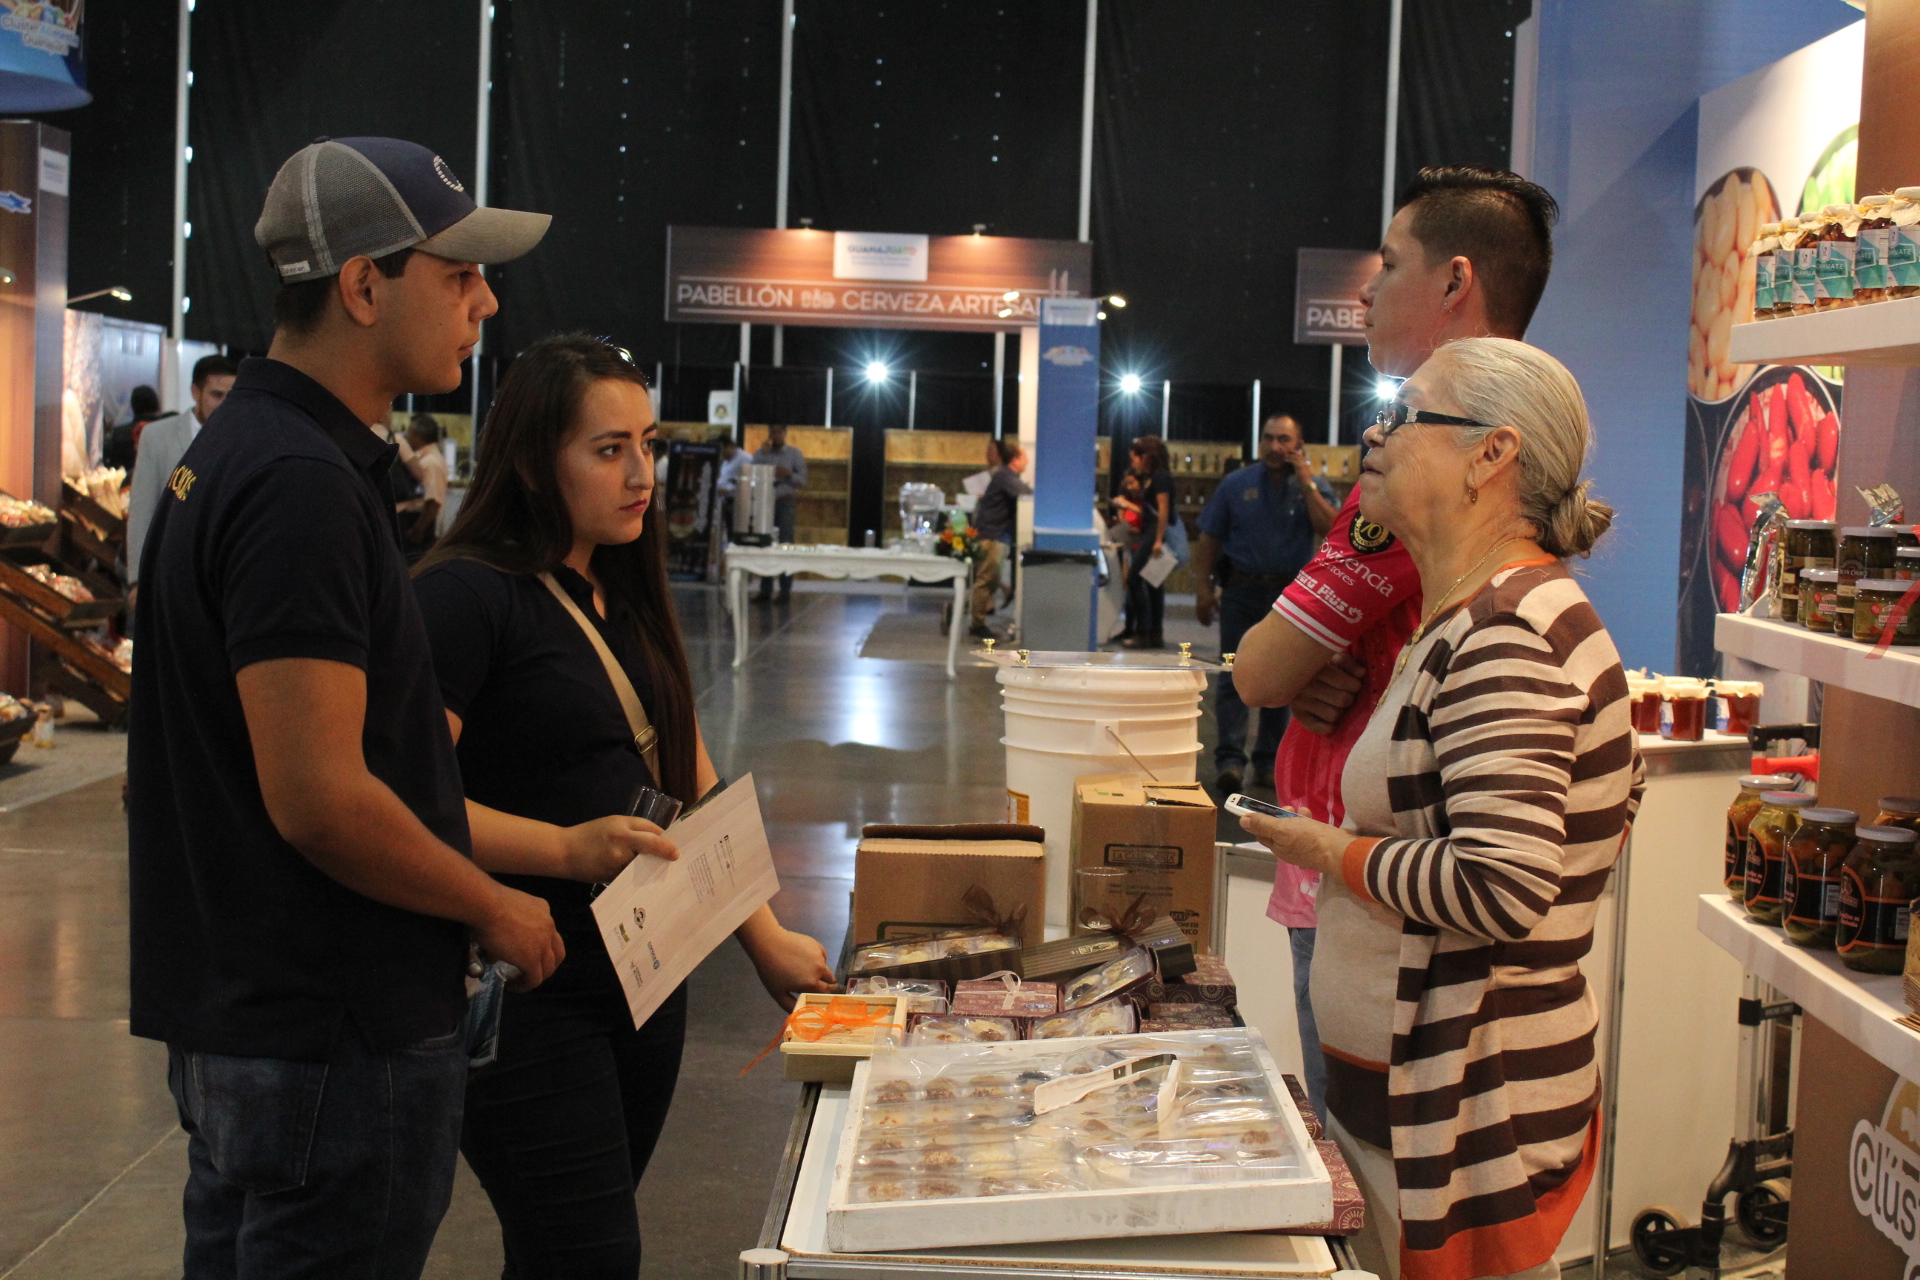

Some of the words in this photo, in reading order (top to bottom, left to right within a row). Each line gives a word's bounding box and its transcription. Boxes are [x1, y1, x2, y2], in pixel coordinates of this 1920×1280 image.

[677, 283, 793, 308] PABELLÓN
[842, 290, 945, 314] CERVEZA
[947, 296, 1040, 316] ARTESA
[1306, 306, 1367, 329] PABE
[1317, 584, 1349, 612] Plus
